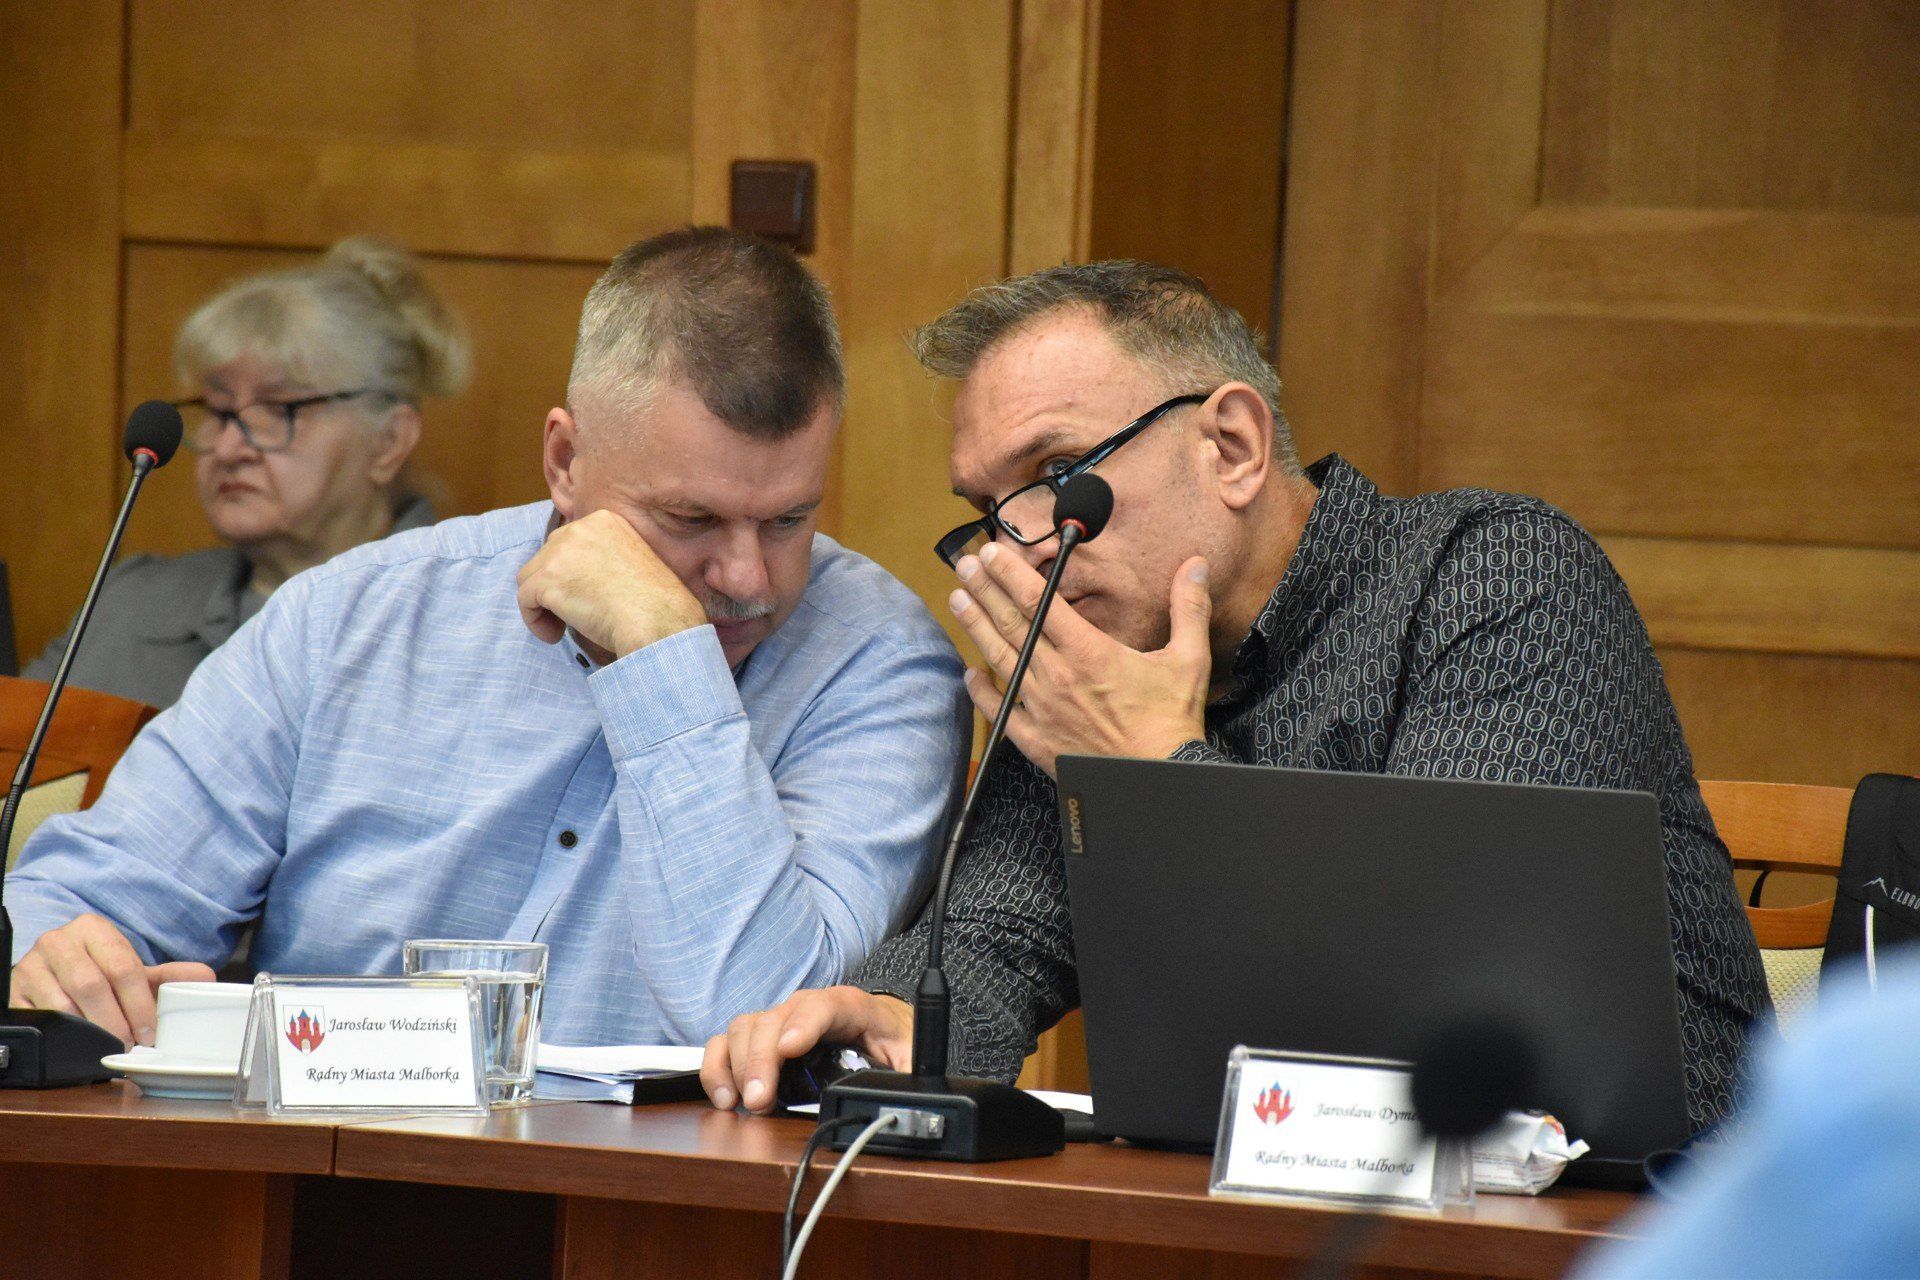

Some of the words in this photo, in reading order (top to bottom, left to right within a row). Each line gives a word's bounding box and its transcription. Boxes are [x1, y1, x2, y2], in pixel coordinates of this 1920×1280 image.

[1068, 798, 1083, 853] Lenovo
[328, 1017, 385, 1032] Jarosław
[389, 1018, 458, 1034] Wodziński
[306, 1067, 347, 1084] Radny
[350, 1068, 395, 1081] Miasta
[399, 1066, 460, 1084] Malborka
[1313, 1103, 1374, 1119] Jarosław
[1378, 1107, 1417, 1125] Dyme
[1255, 1150, 1297, 1170] Radny
[1301, 1153, 1348, 1170] Miasta
